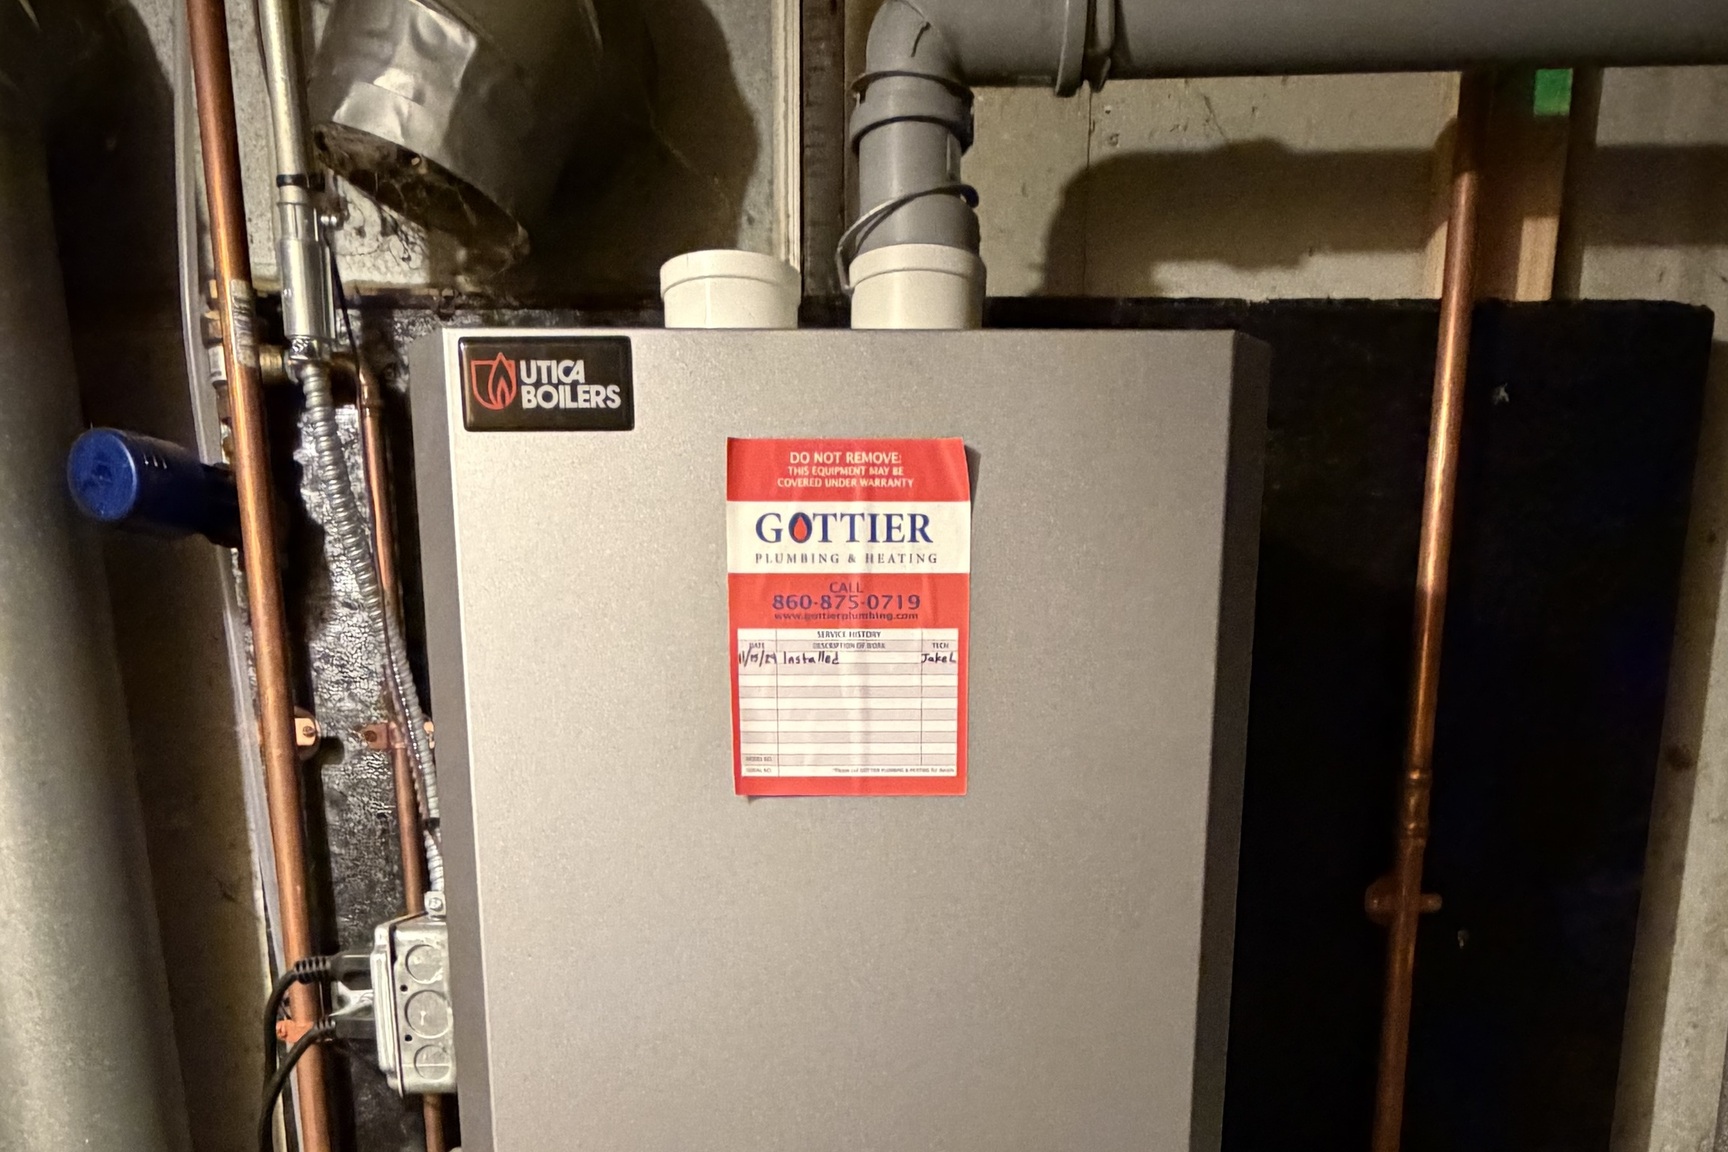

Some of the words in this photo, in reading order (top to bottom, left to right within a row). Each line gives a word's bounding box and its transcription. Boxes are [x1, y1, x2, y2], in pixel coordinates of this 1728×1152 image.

[519, 359, 586, 384] UTICA
[520, 384, 622, 410] BOILERS
[789, 451, 810, 464] DO
[813, 451, 842, 464] NOT
[788, 466, 809, 476] THIS
[812, 466, 866, 477] EQUIPMENT
[868, 466, 890, 476] MAY
[892, 466, 904, 476] BE
[777, 478, 822, 488] COVERED
[825, 478, 857, 488] UNDER
[859, 478, 914, 488] WARRANTY
[755, 511, 934, 544] GOTTIER
[755, 553, 840, 564] PLUMBING
[847, 553, 857, 564] &
[865, 553, 937, 564] HEATING
[829, 582, 864, 594] CALL
[772, 594, 921, 610] 860-875-0719
[817, 630, 846, 638] SERVICE
[849, 630, 881, 638] HISTORY
[783, 650, 840, 665] Installed
